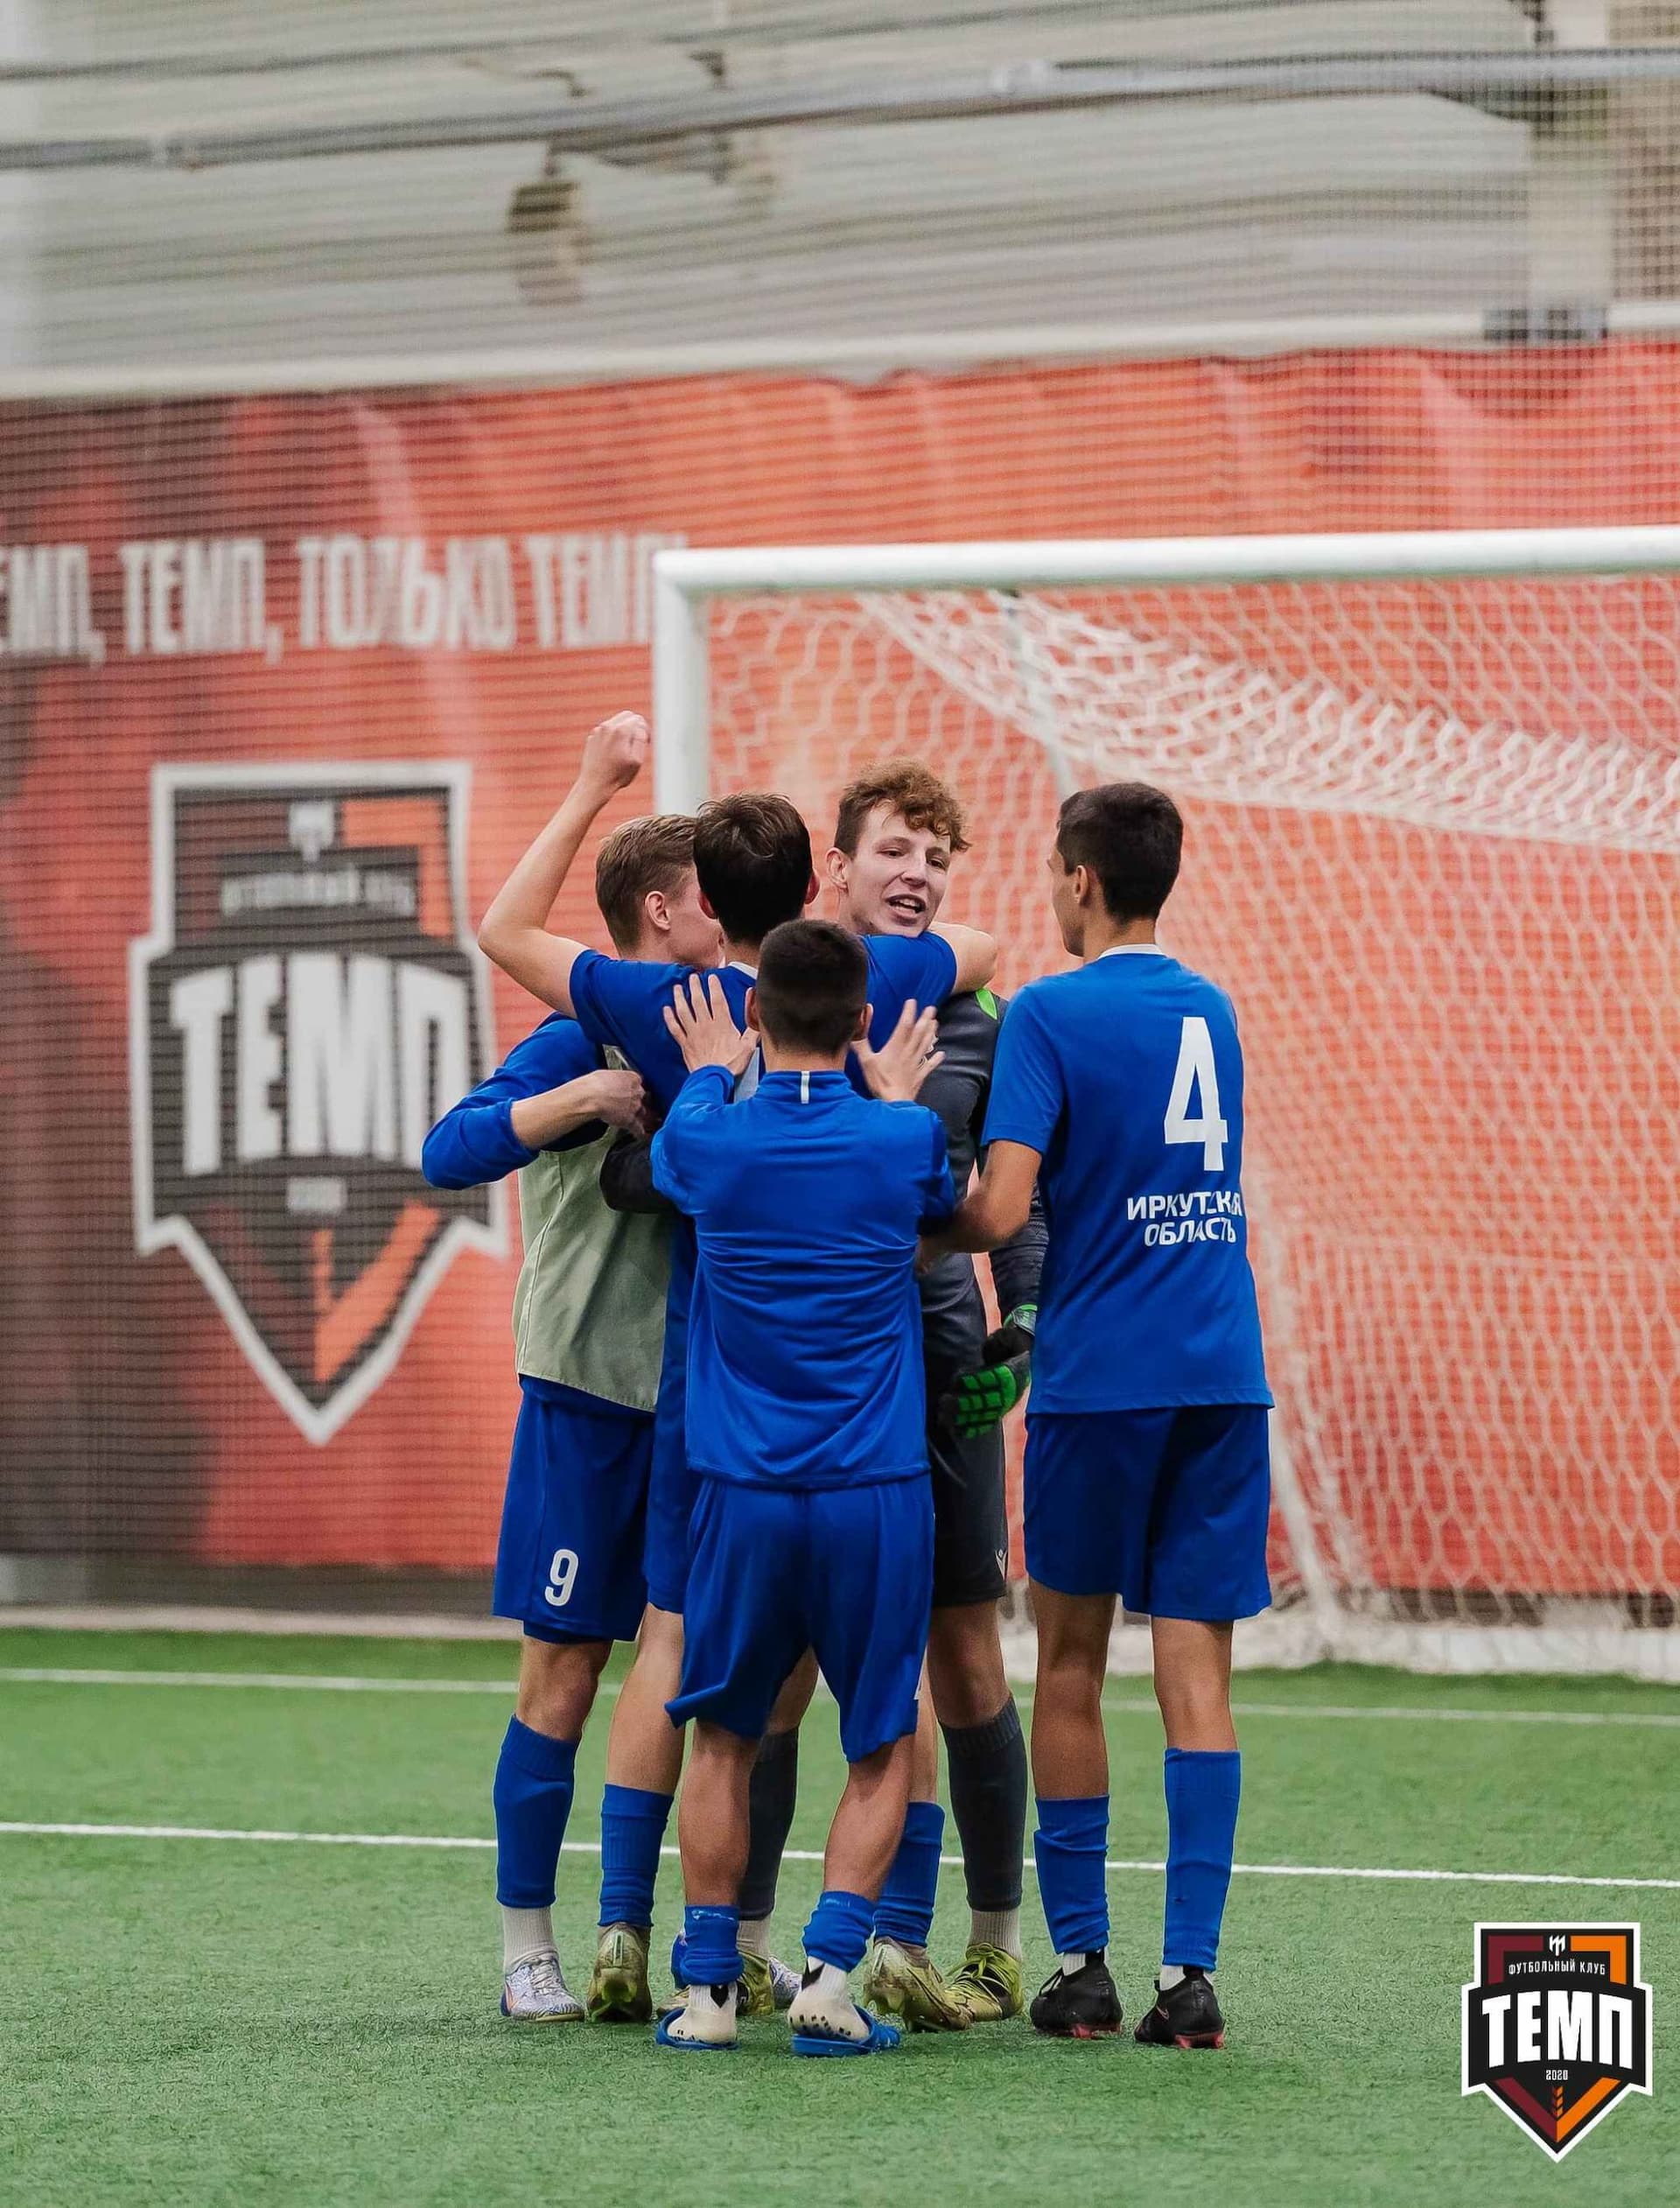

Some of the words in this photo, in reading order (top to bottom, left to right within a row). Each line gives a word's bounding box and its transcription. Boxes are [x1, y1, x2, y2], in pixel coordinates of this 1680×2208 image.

[119, 538, 282, 666] ТЕМП,
[298, 535, 516, 651] ТОЛЬКО
[172, 951, 472, 1177] ТЕМП
[1164, 1016, 1228, 1172] 4
[1144, 1216, 1236, 1247] ОБЛАСТЬ
[544, 1548, 579, 1607] 9
